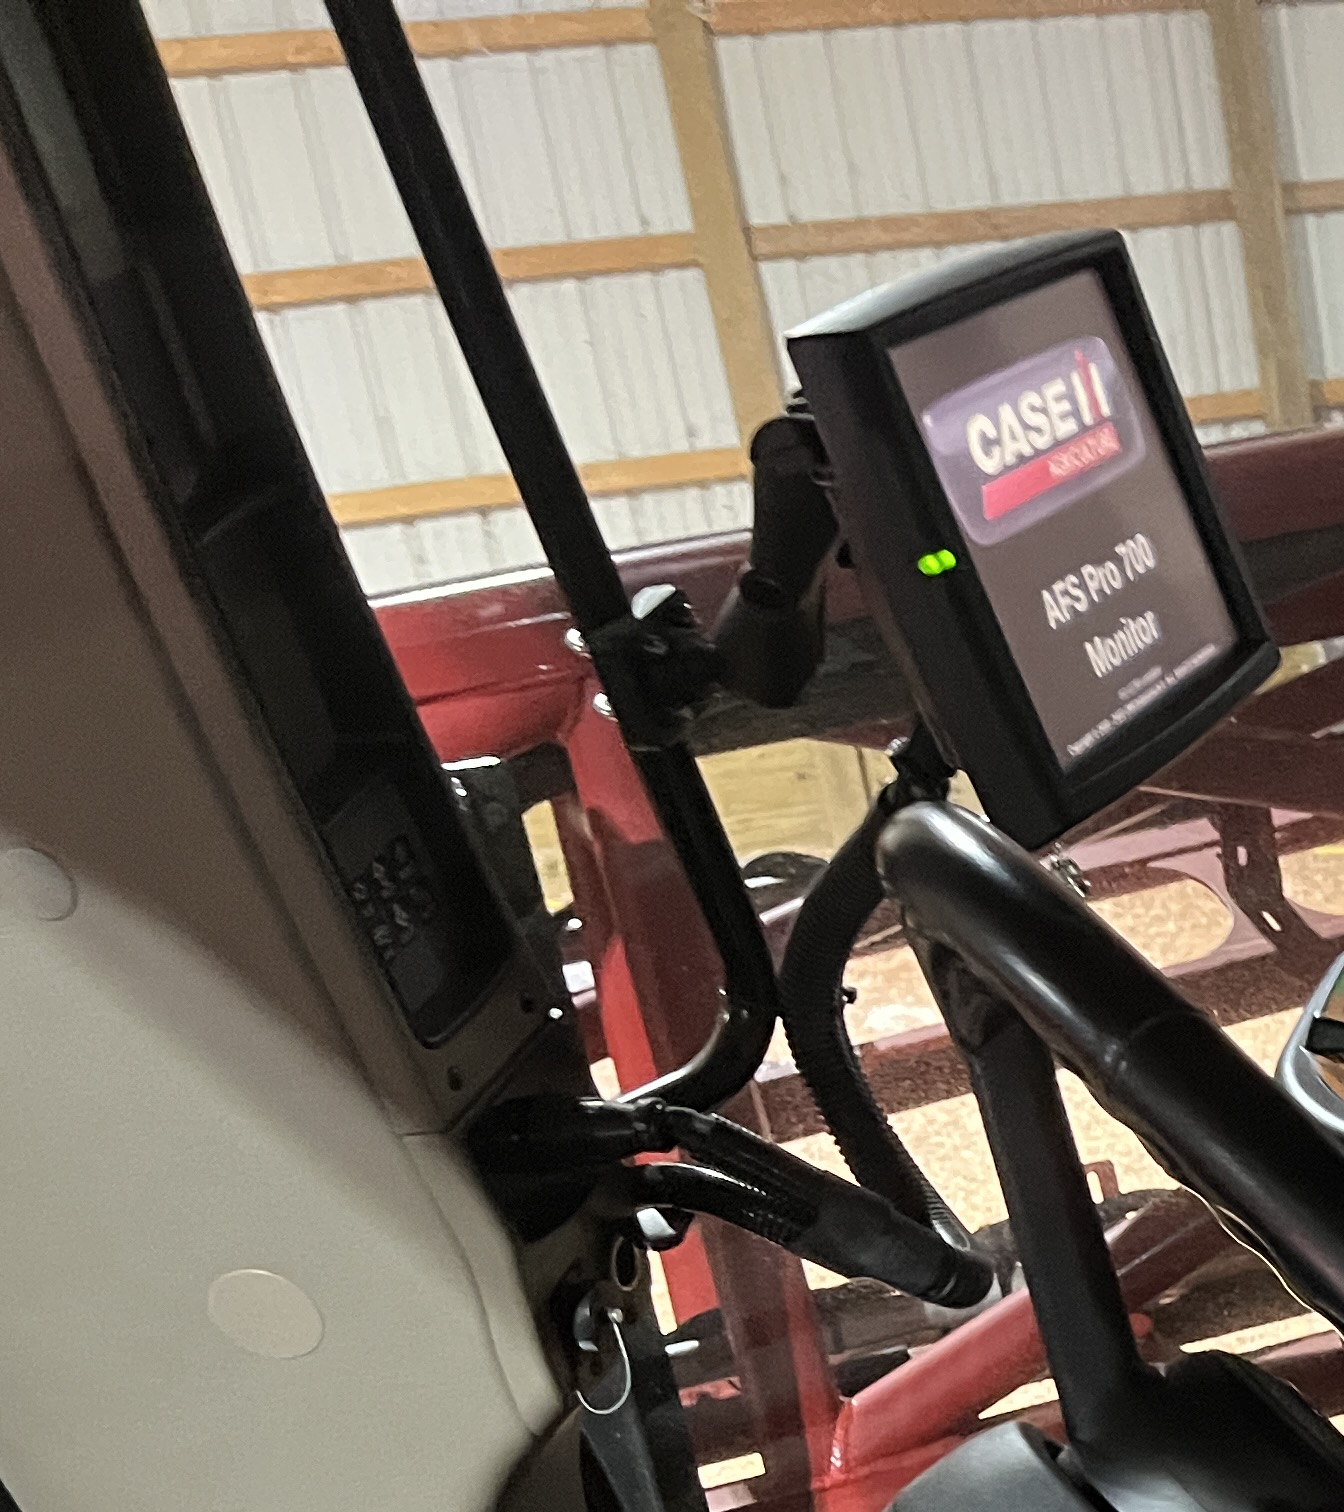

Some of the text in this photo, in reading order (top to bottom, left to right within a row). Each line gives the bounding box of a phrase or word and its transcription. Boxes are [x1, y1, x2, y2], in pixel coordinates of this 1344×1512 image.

[966, 378, 1079, 475] CASE
[1041, 533, 1156, 630] AFS Pro 700
[1083, 610, 1160, 678] Monitor
